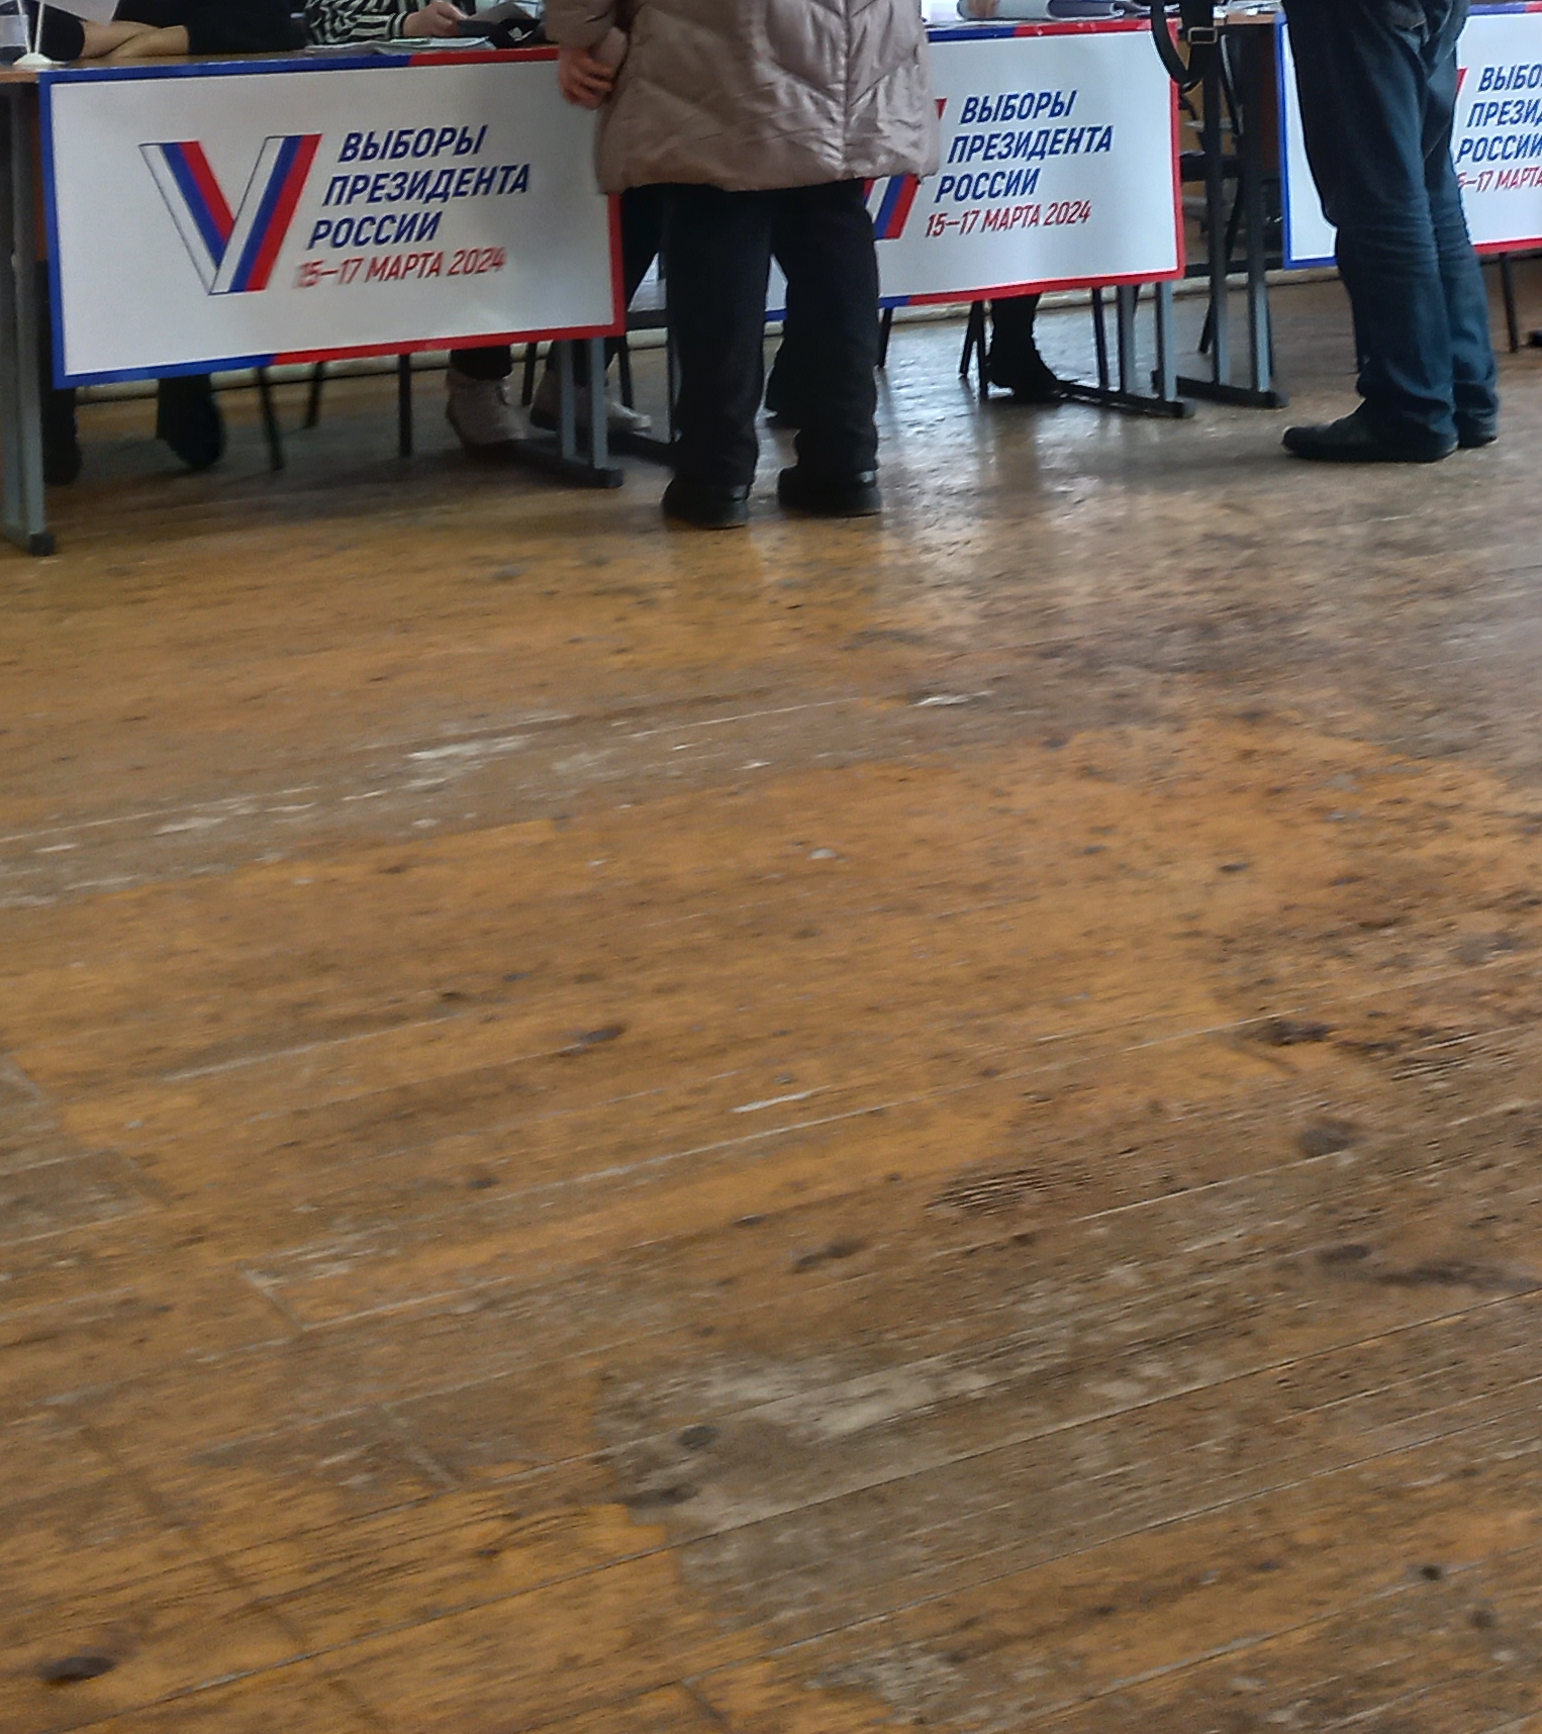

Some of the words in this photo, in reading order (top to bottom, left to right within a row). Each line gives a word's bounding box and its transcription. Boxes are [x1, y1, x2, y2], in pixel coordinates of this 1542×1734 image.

[960, 90, 1076, 125] ВЫБОРЫ
[339, 124, 489, 163] ВЫБОРЫ
[948, 125, 1113, 166] ПРЕЗИДЕНТА
[322, 165, 530, 207] ПРЕЗИДЕНТА
[936, 168, 1039, 204] РОССИИ
[307, 211, 441, 251] РОССИИ
[980, 204, 1042, 234] МАРТА
[1043, 200, 1091, 227] 2024
[366, 251, 444, 285] МАРТА
[448, 246, 505, 276] 2024
